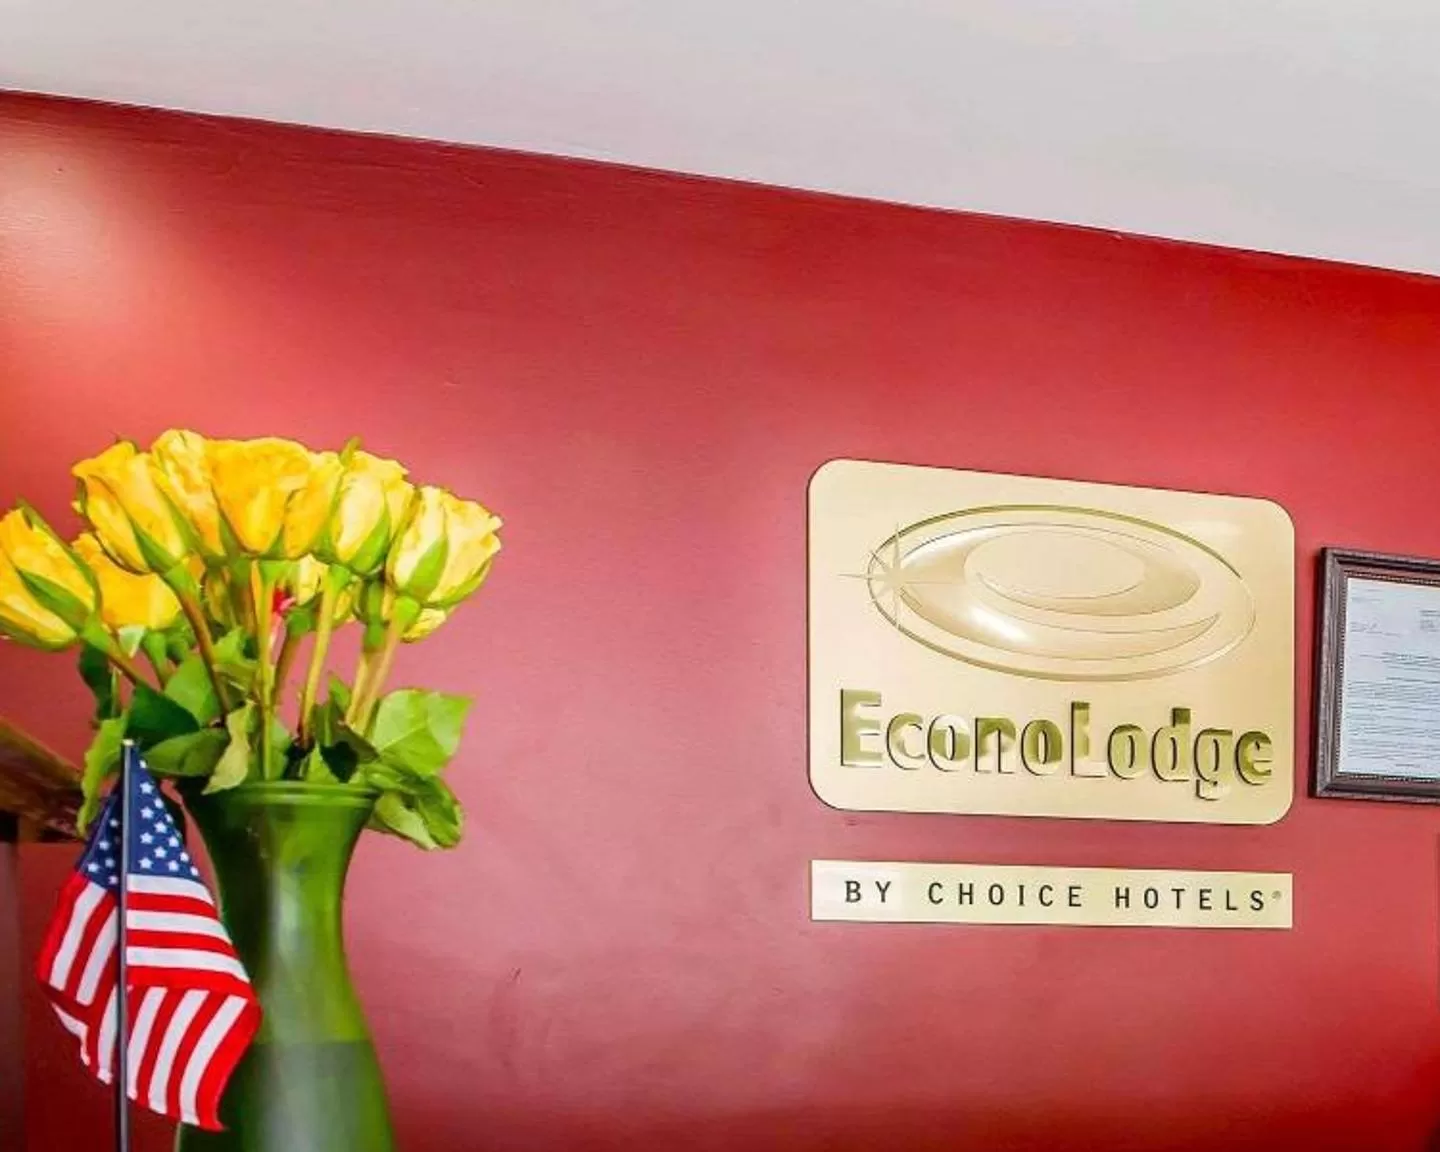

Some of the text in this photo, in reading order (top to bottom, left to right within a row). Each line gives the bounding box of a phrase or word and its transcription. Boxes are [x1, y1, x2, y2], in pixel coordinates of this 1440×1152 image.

[839, 688, 1274, 801] EconoLodge
[845, 880, 892, 904] BY
[928, 881, 1083, 908] CHOICE
